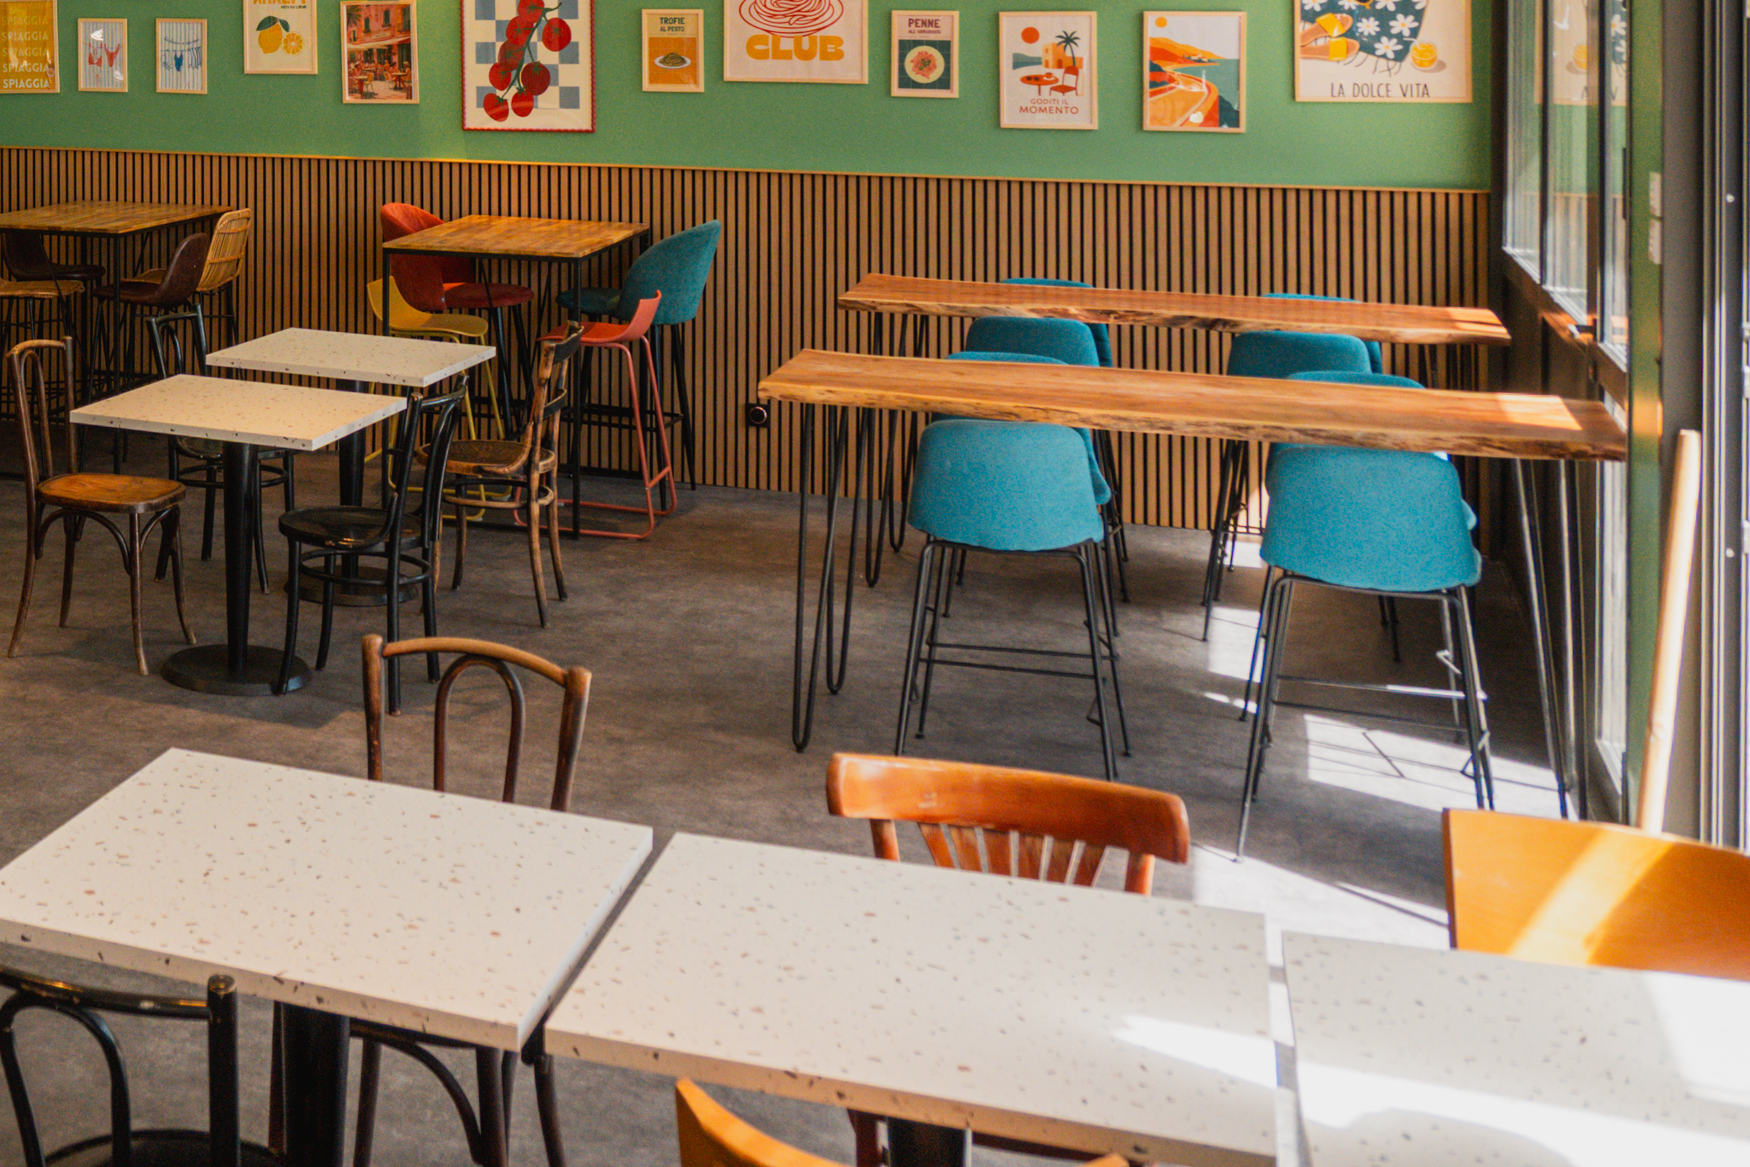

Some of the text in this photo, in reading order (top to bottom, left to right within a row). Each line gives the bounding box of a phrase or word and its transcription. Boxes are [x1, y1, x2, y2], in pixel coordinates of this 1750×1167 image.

[660, 17, 686, 25] TROFIE
[908, 18, 942, 28] PENNE
[2, 31, 49, 41] SPIAGGIA
[2, 47, 49, 57] SPIAGGIA
[745, 34, 846, 62] CLUB
[2, 63, 49, 73] SPIAGGIA
[2, 78, 51, 89] SPIAGGIA
[1330, 82, 1432, 98] LA DOLCE VITA
[1019, 105, 1079, 115] MOMENTO
